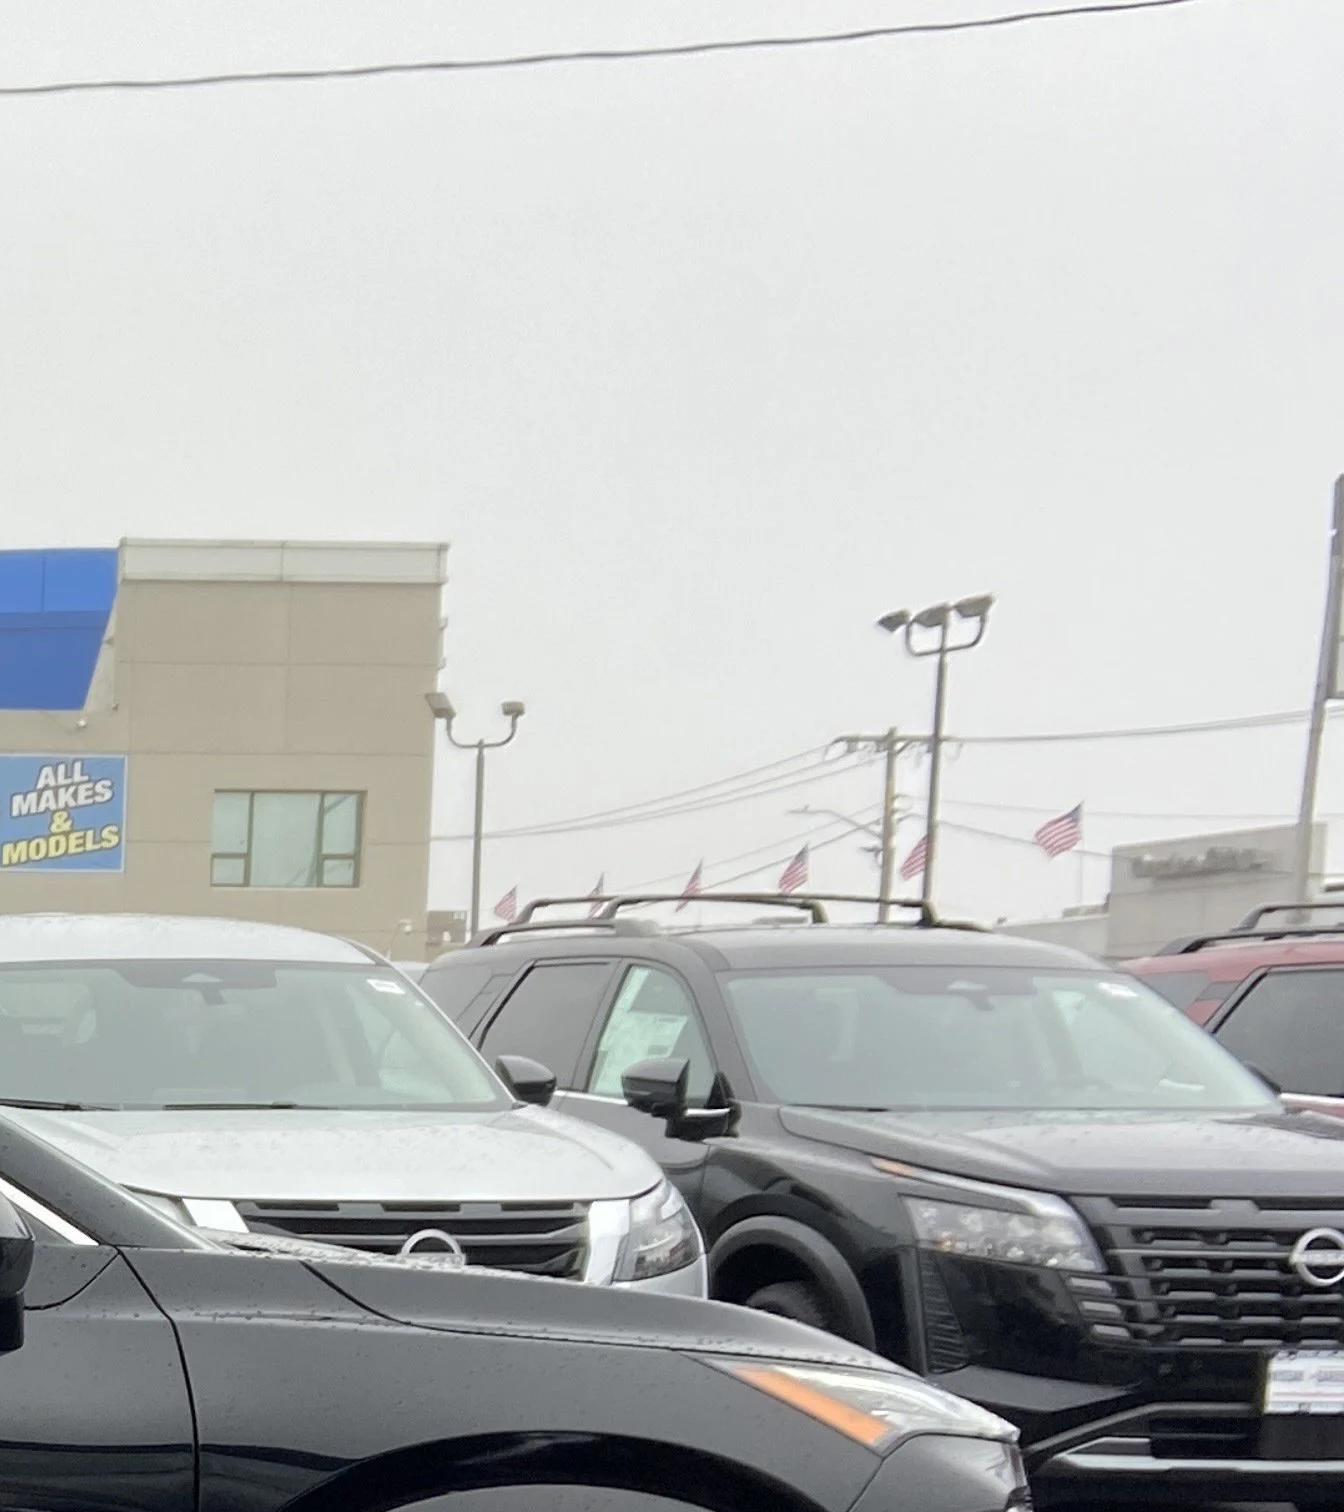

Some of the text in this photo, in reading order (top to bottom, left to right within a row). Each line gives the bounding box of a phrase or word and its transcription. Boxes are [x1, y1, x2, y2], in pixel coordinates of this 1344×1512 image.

[35, 760, 90, 791] ALL
[11, 779, 113, 817] MAKES
[49, 810, 73, 834] &
[1, 824, 120, 867] MODELS
